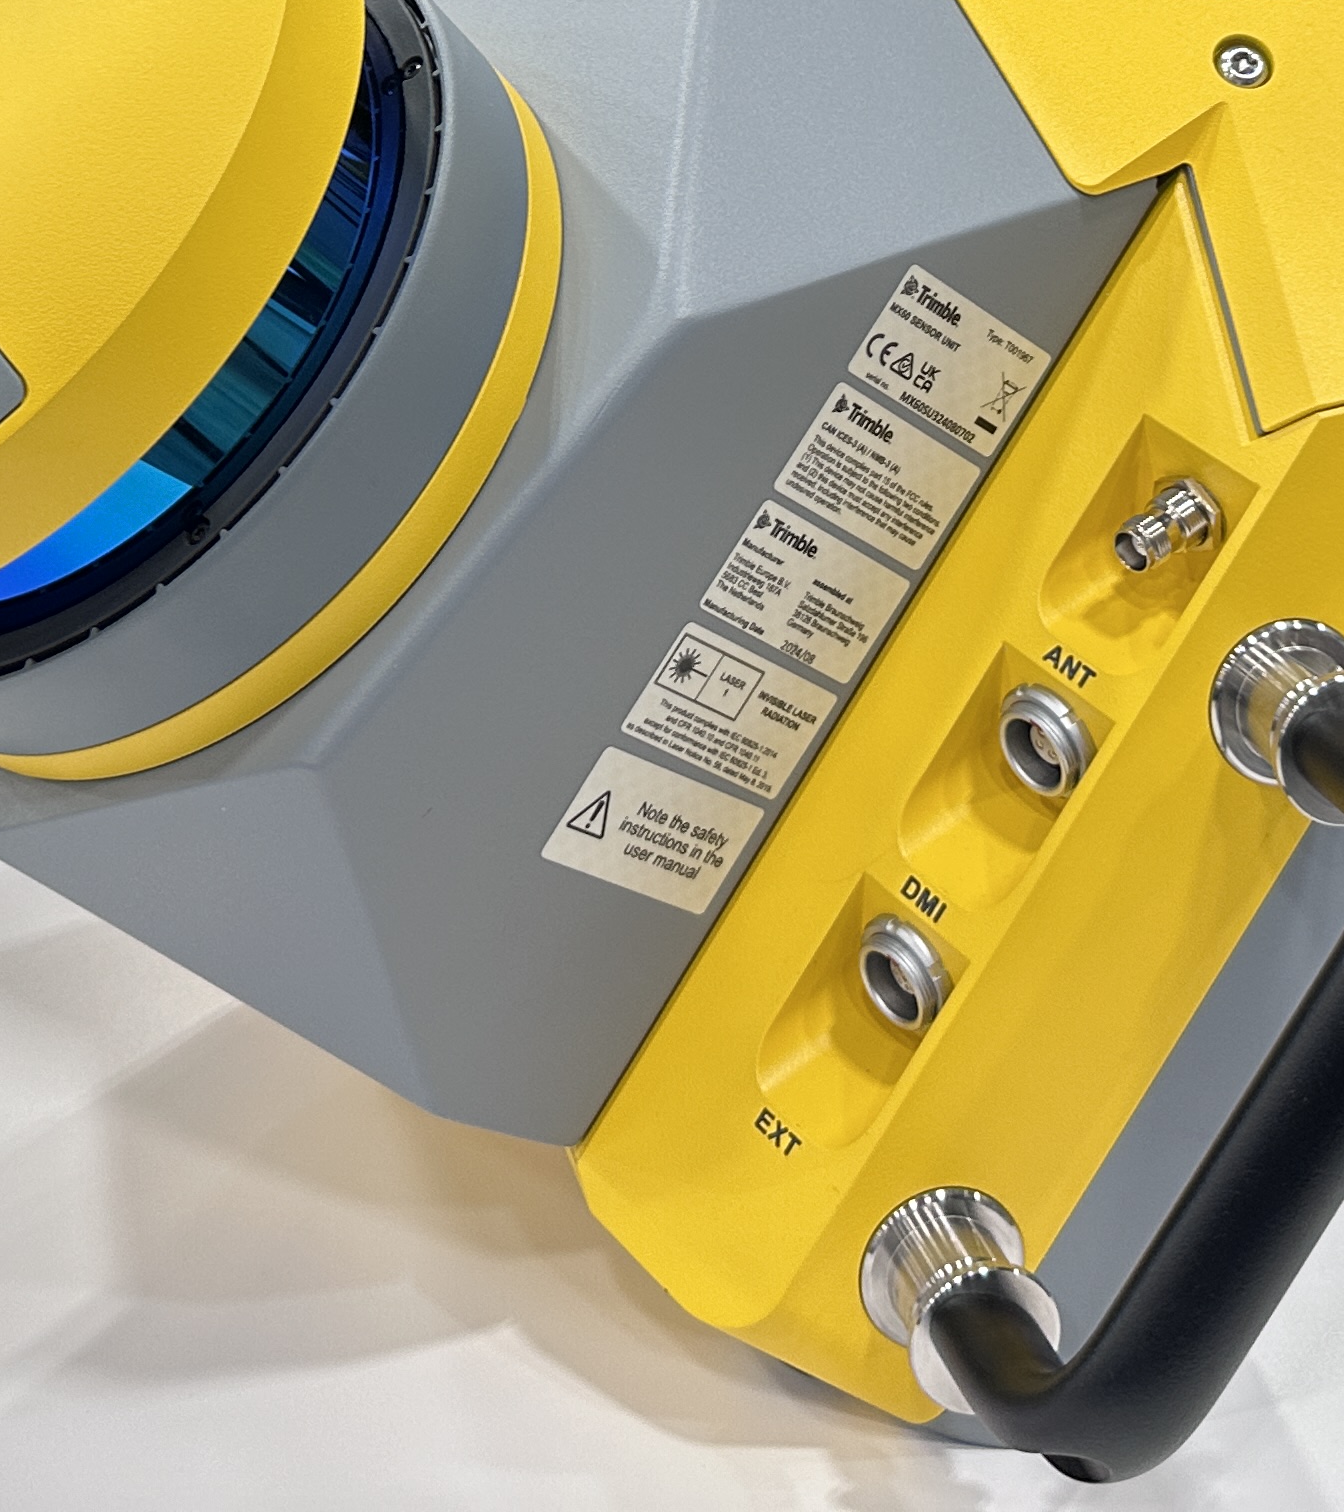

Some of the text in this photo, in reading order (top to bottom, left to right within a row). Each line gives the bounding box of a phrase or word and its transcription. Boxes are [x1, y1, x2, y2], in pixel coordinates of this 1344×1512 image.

[890, 302, 961, 352] MX60 SENSOR UNIT
[720, 672, 746, 690] LASER
[1043, 644, 1097, 690] ANT
[758, 691, 817, 725] INVISIBLE LASER
[761, 707, 800, 731] RADIATION
[619, 816, 724, 868] instructions in the
[637, 801, 729, 851] Note the safety
[624, 843, 701, 879] user manual
[899, 875, 948, 924] DMI
[754, 1107, 802, 1157] EXT
